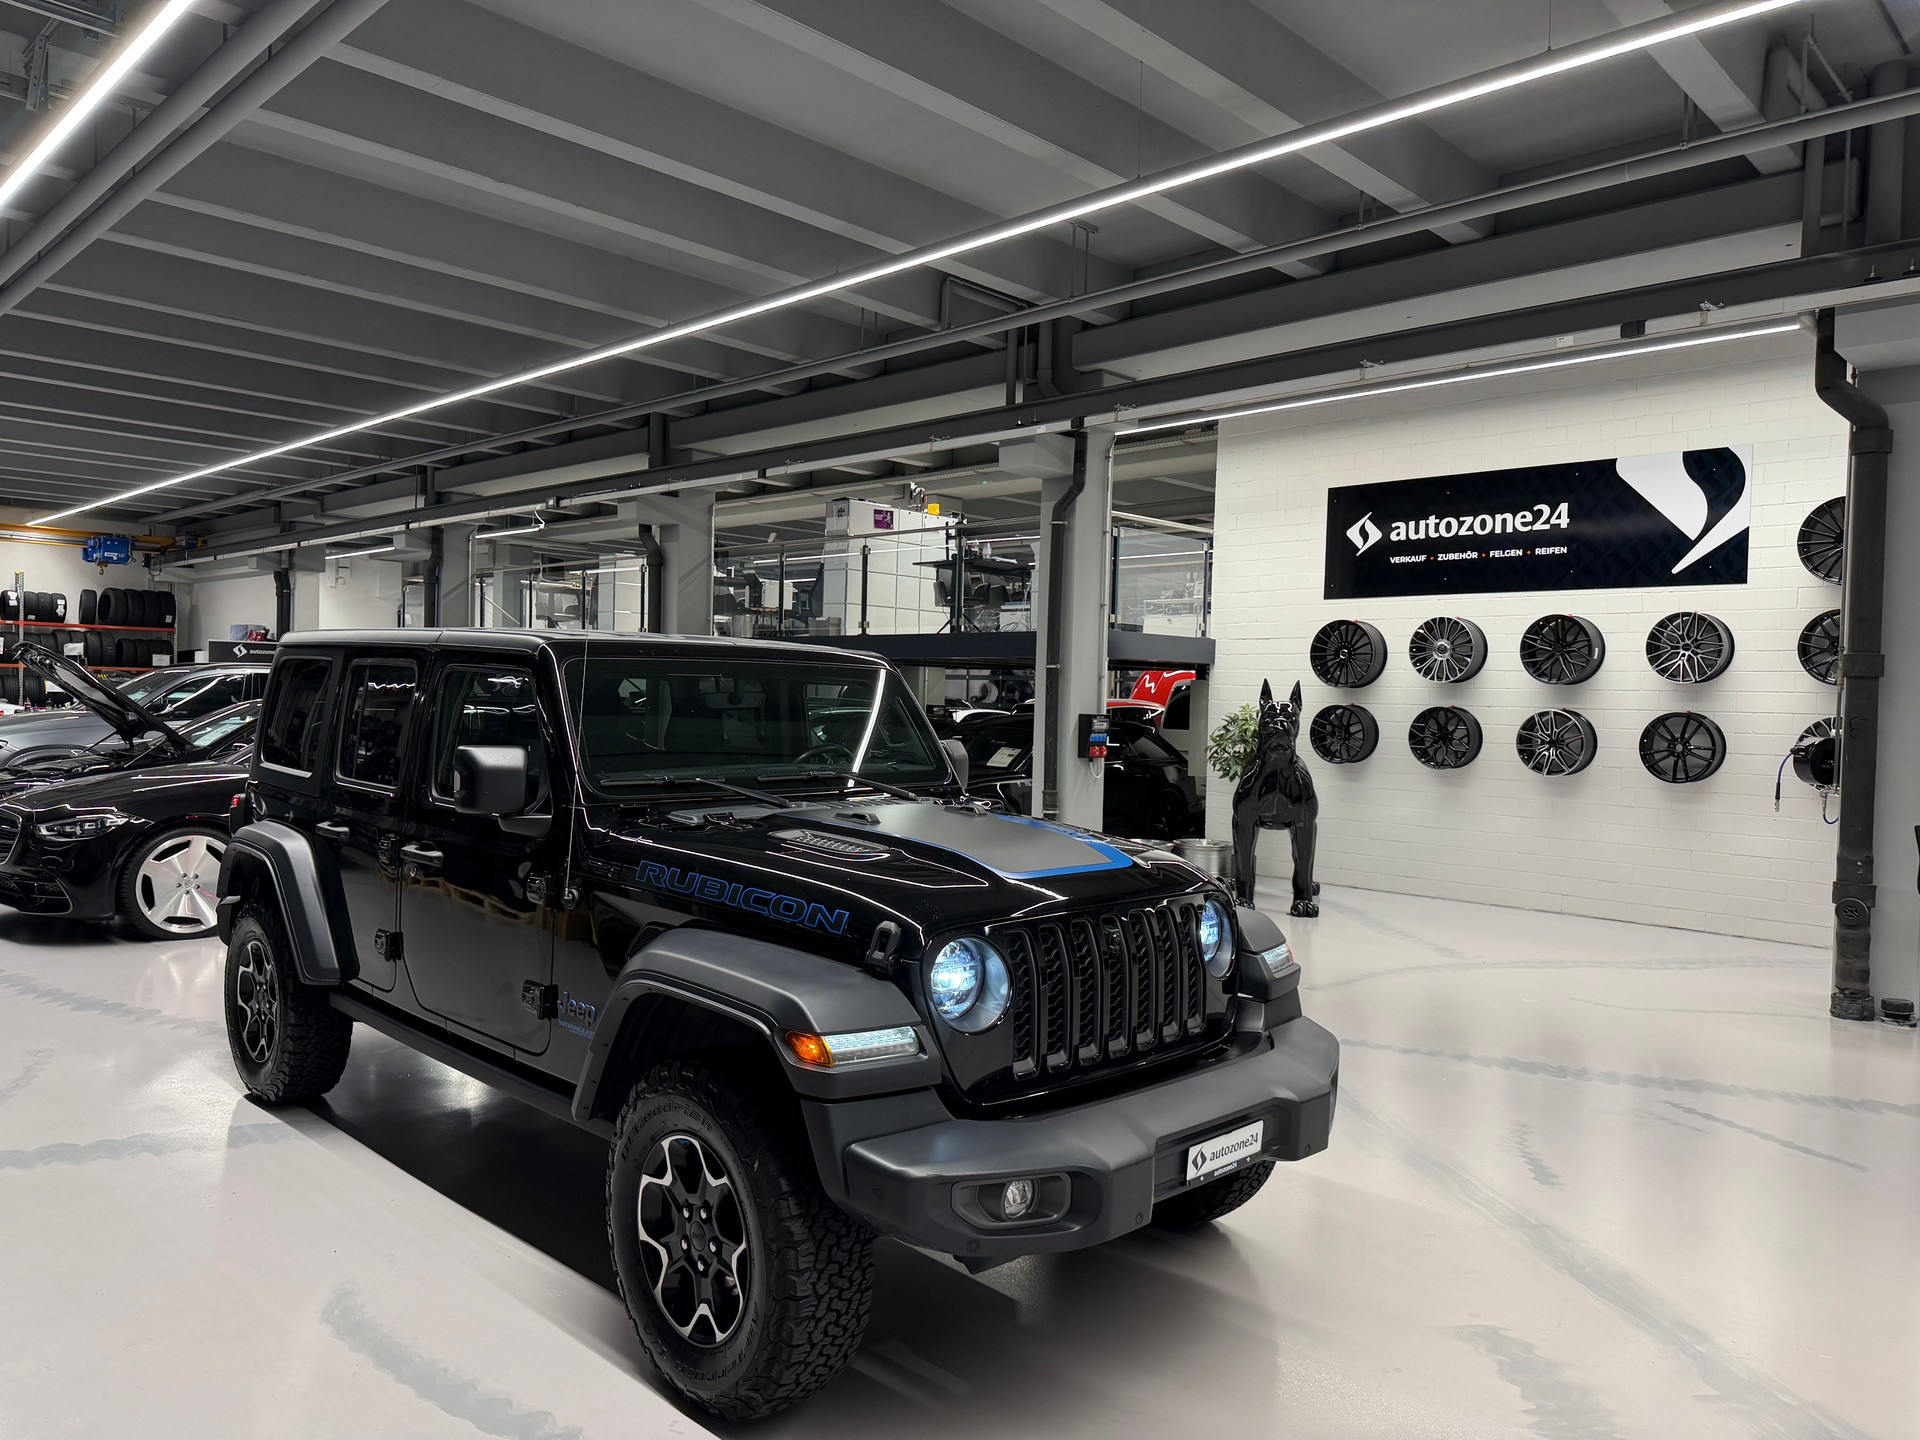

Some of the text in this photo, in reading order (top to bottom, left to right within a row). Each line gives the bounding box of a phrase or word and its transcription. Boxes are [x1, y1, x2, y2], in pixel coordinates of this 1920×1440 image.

[1389, 502, 1570, 542] autozone24
[1389, 546, 1567, 565] VERKAUF ZUBEHÖR FELGEN REIFEN
[635, 859, 850, 935] RUBICON
[557, 991, 598, 1026] Jeep
[1209, 1132, 1259, 1162] autozone24
